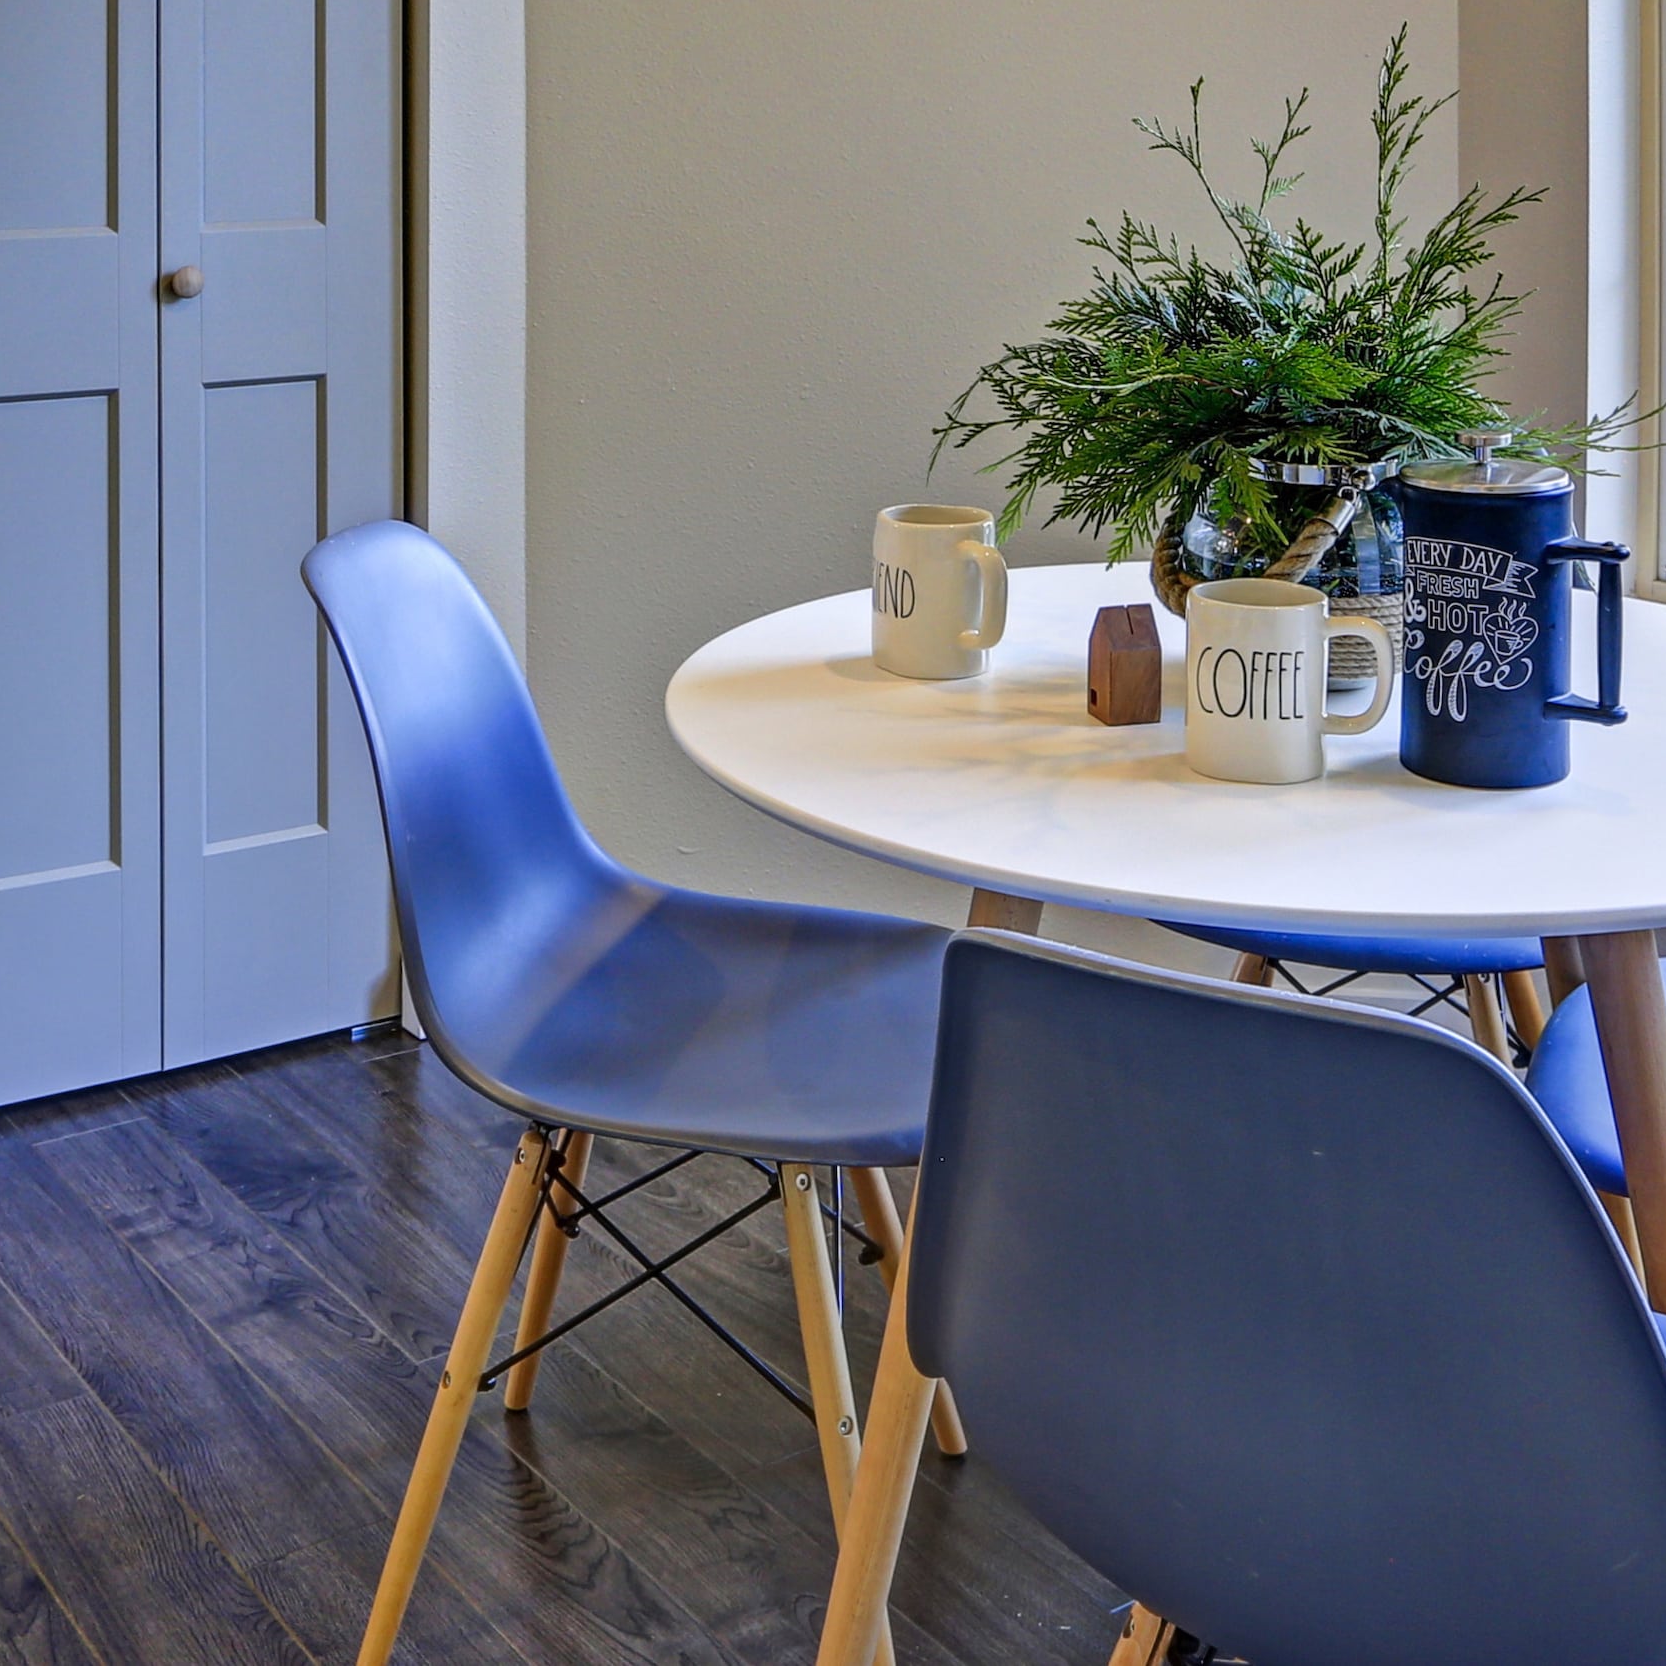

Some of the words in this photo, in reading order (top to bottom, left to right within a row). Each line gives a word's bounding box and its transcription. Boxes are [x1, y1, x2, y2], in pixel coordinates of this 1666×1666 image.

[1407, 540, 1452, 567] EVERY
[1460, 547, 1503, 576] DAY
[1416, 570, 1480, 599] FRESH
[1404, 578, 1427, 623] &
[1427, 598, 1489, 636] HOT
[1196, 646, 1305, 720] COFFEE
[1404, 627, 1533, 722] Coffee
